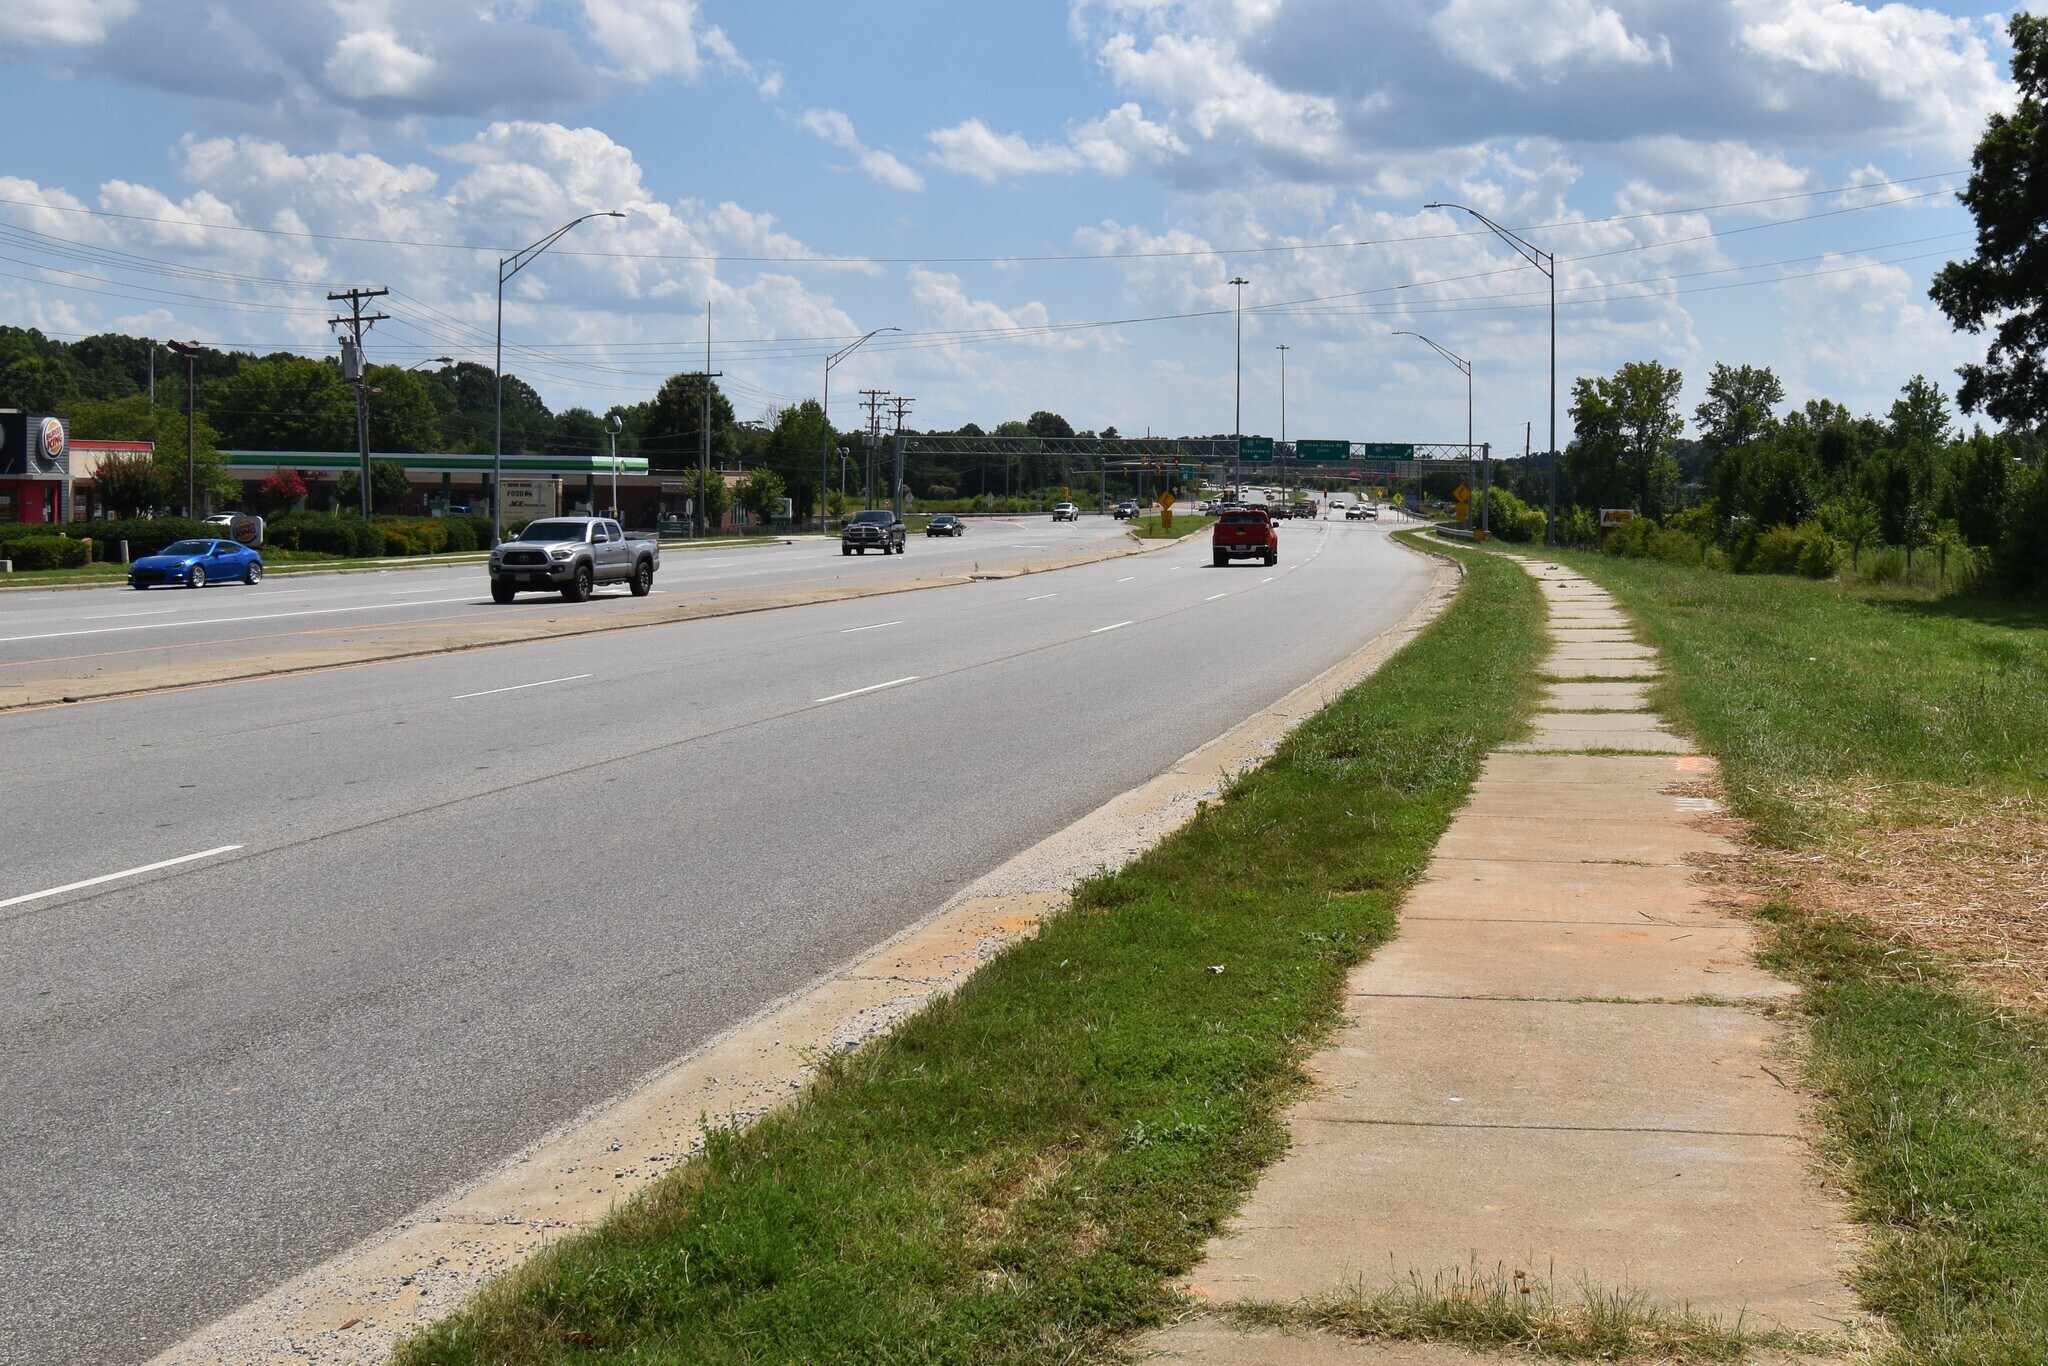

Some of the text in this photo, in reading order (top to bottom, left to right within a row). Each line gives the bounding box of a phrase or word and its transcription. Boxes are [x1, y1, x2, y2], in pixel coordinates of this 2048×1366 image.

[46, 426, 62, 441] BURGER
[47, 433, 62, 451] KING
[509, 500, 525, 508] ACE
[235, 527, 257, 539] KING
